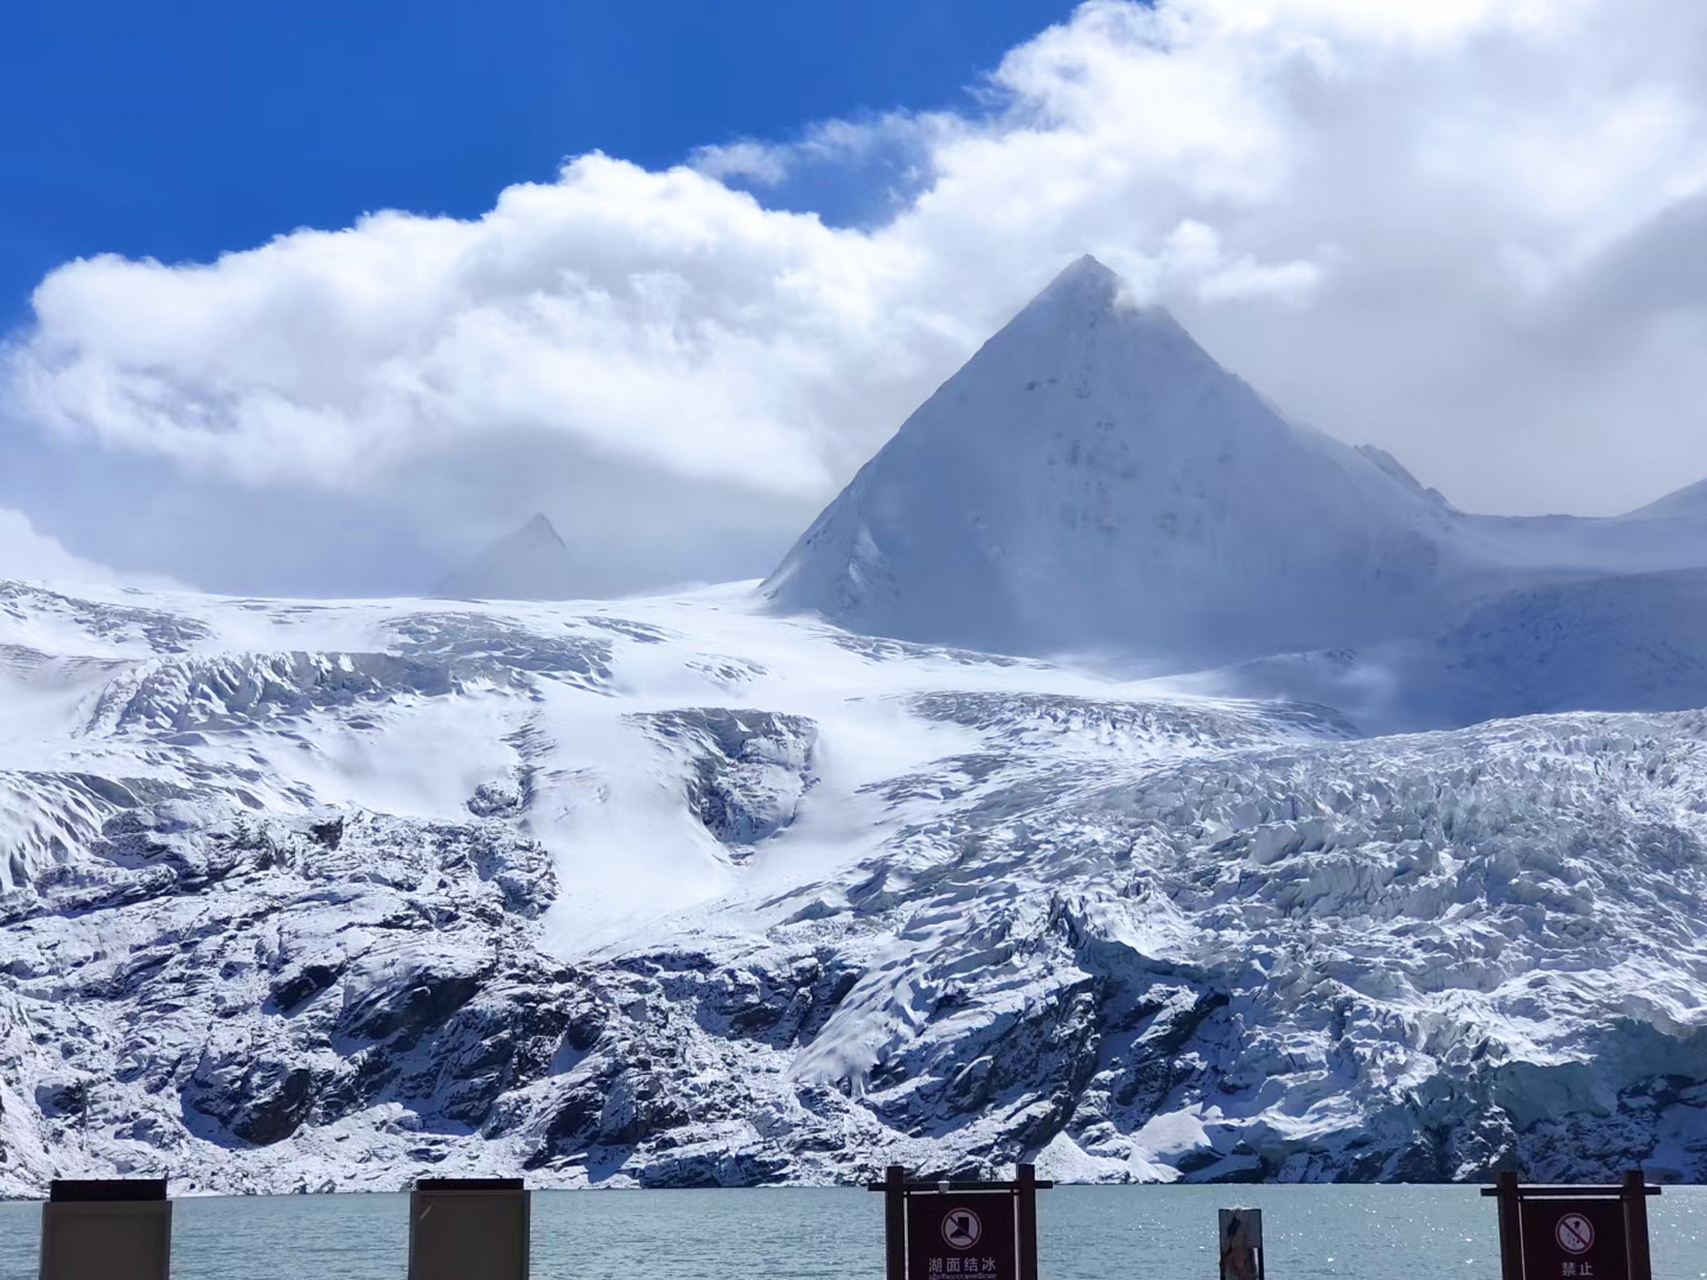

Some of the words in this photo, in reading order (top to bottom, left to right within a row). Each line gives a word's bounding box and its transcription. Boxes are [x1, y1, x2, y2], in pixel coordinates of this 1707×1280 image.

[928, 1257, 996, 1273] 湖面结冰
[1562, 1261, 1594, 1276] 禁止
